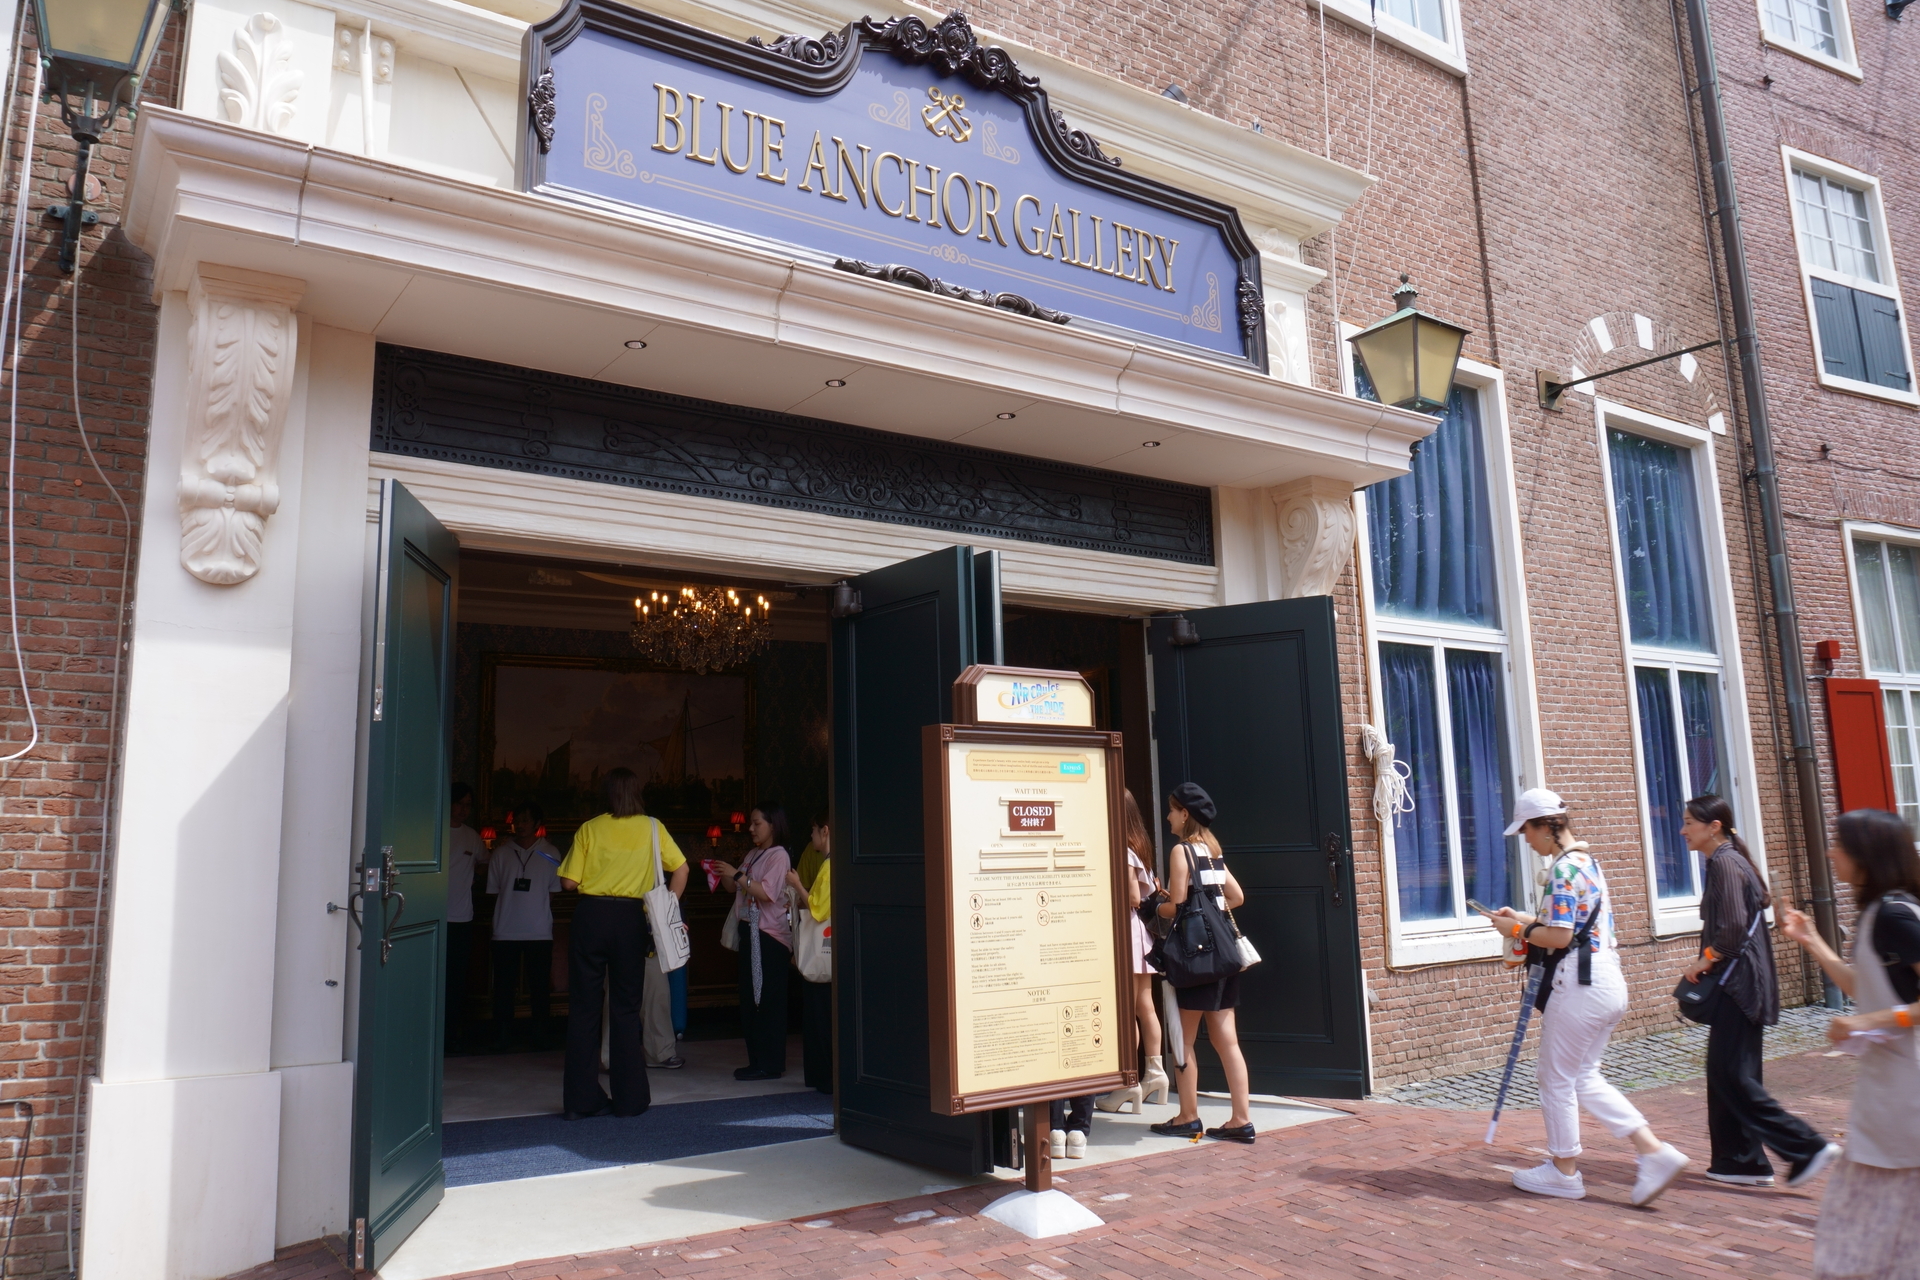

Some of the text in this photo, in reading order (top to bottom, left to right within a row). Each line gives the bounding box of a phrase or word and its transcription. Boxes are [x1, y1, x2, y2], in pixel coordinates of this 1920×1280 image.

[651, 82, 1180, 293] BLUE ANCHOR GALLERY
[1012, 682, 1029, 706] AIR
[1030, 701, 1065, 716] THE RIDE
[1012, 806, 1053, 817] CLOSED
[1020, 817, 1045, 827] 受付終了
[1027, 989, 1051, 997] NOTICE
